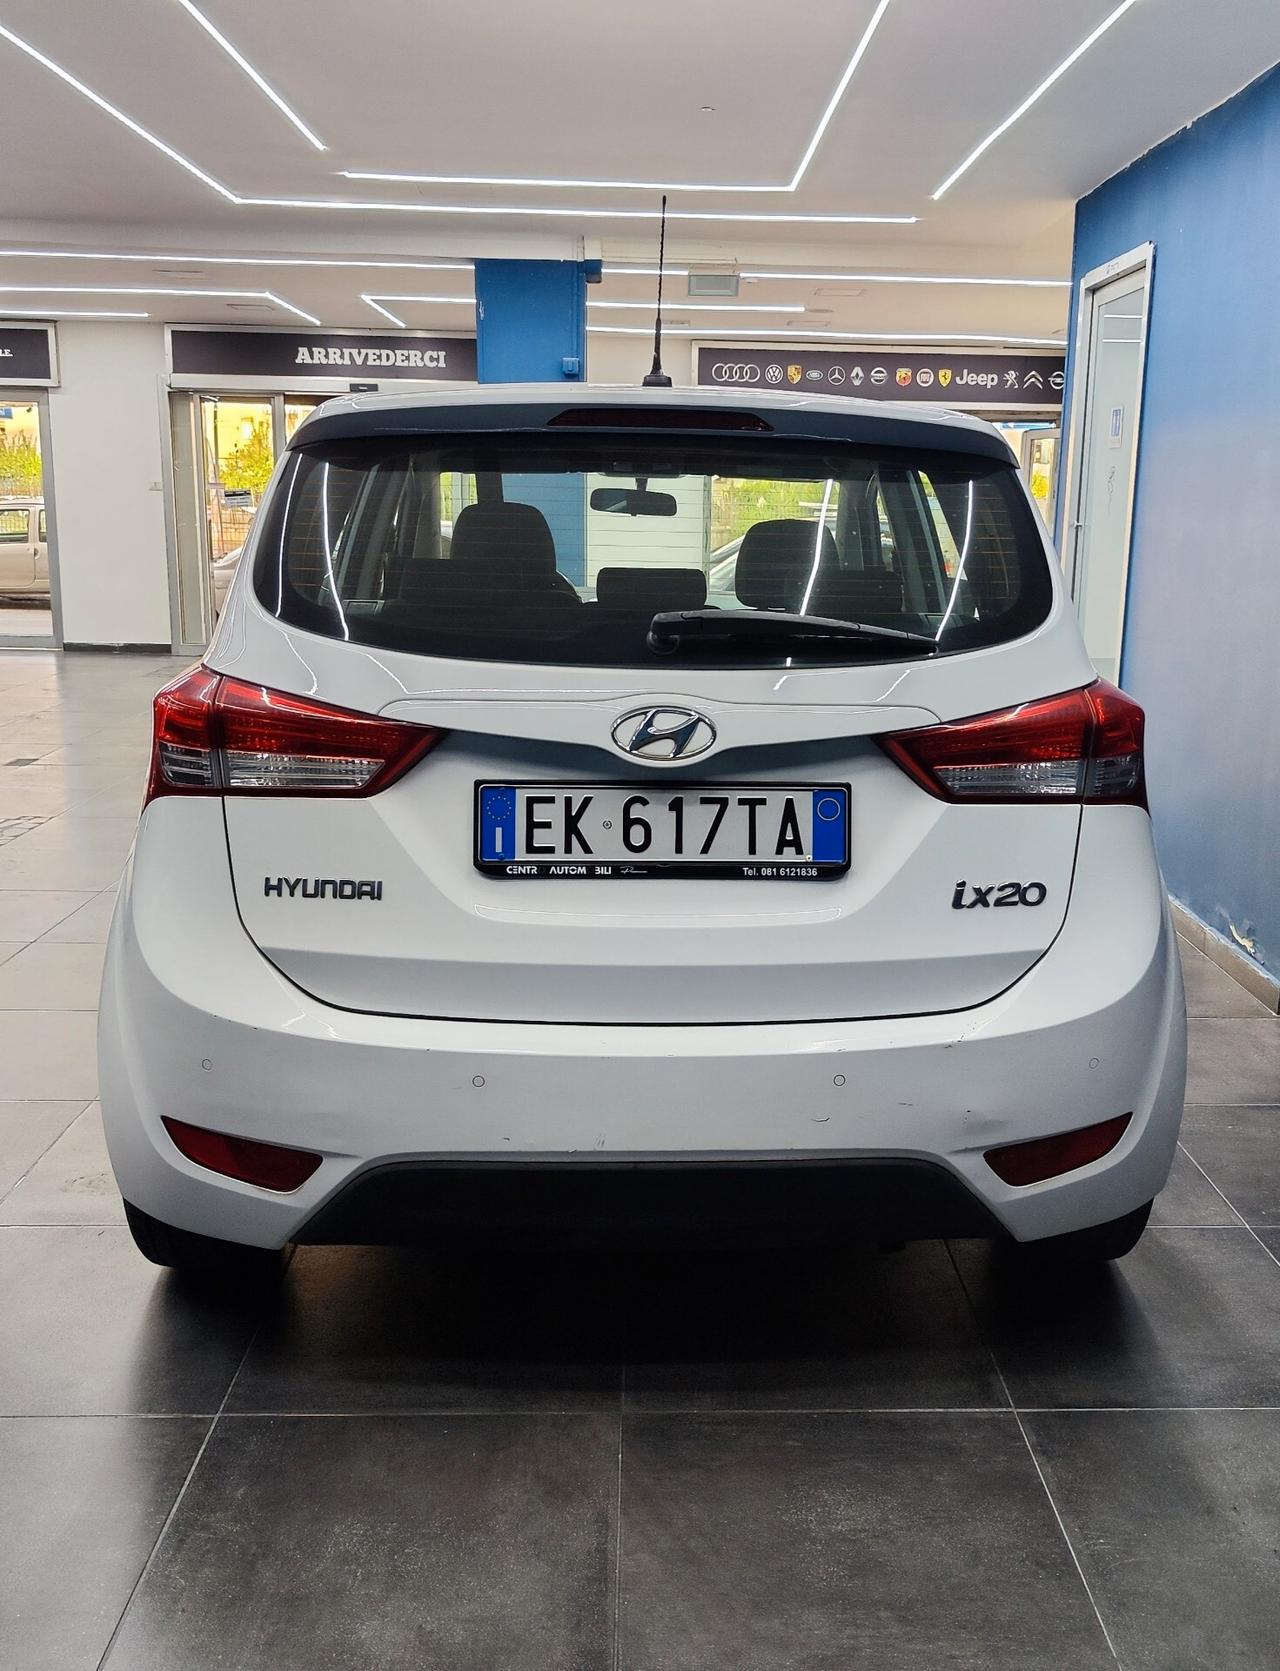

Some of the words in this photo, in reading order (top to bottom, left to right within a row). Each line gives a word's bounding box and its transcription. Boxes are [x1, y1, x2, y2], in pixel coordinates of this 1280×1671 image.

[295, 347, 446, 368] ARRIVEDERCI
[955, 368, 998, 388] Jeep
[524, 795, 594, 856] EK
[622, 795, 805, 856] 617TA
[506, 865, 546, 875] CENTR
[742, 867, 759, 876] Tel.
[761, 867, 777, 876] 081
[779, 867, 818, 877] 6121836
[264, 877, 383, 901] HYUNDAI
[951, 880, 1047, 910] ix20
